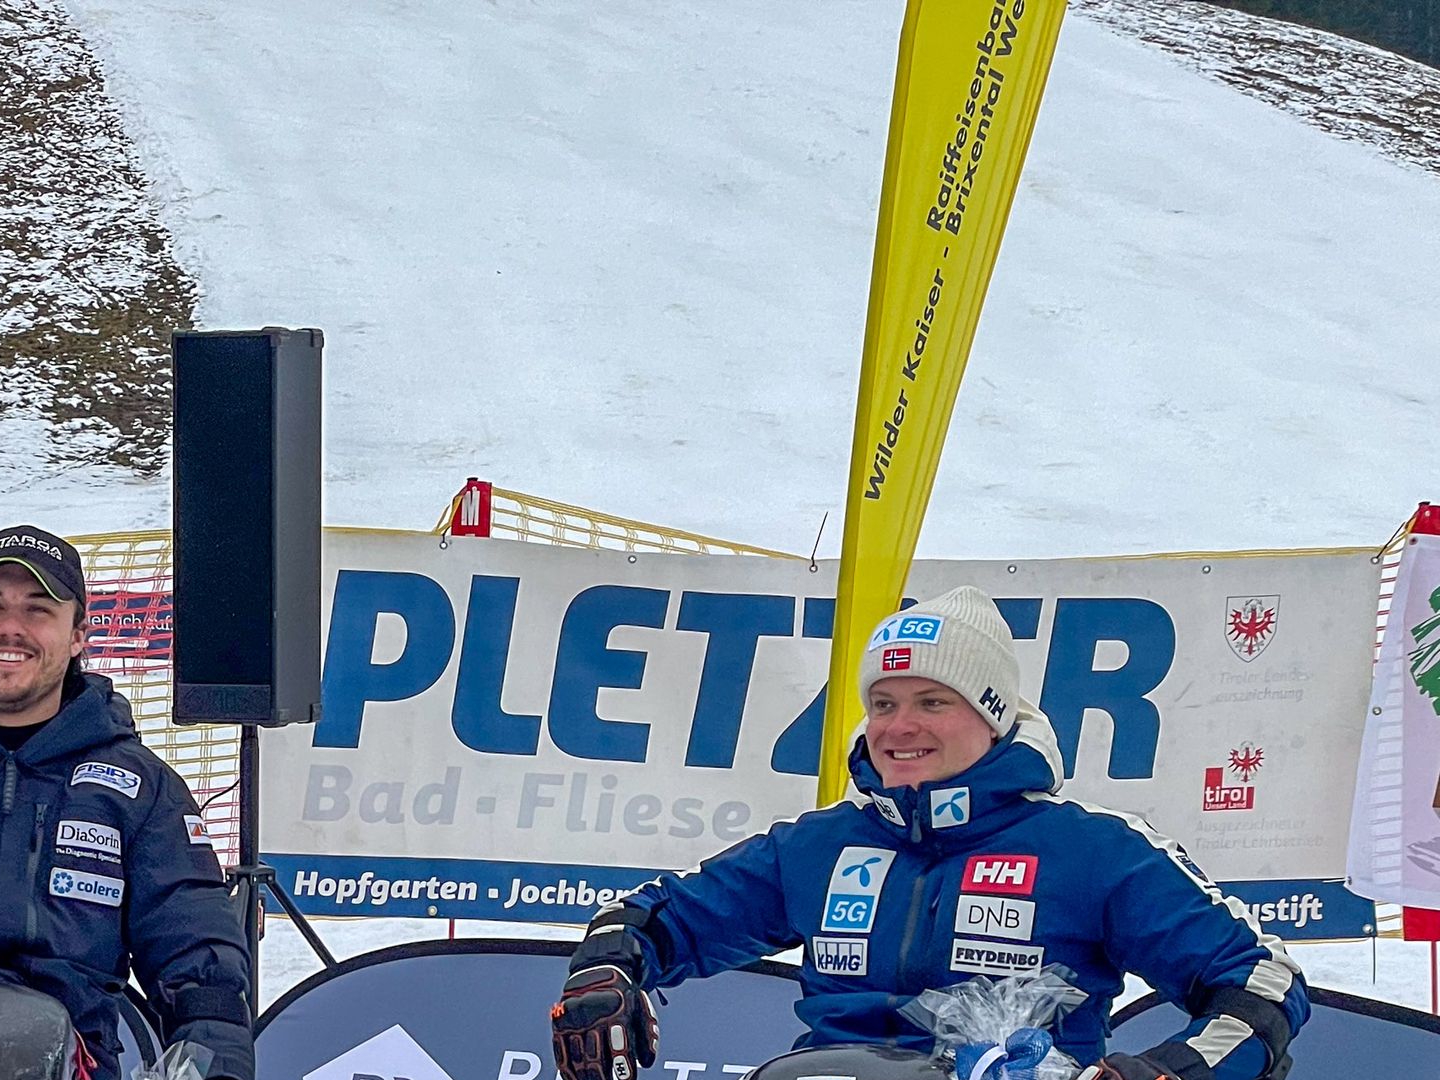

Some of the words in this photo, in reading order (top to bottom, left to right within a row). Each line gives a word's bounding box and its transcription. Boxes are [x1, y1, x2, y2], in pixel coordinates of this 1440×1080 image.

[926, 0, 1007, 231] Raiffeisenba
[864, 389, 906, 500] Wilder
[902, 269, 945, 381] Kaiser
[945, 68, 1005, 236] Brixental
[901, 619, 935, 636] 5G
[978, 686, 1007, 722] HH
[74, 763, 127, 779] FISIP
[302, 764, 462, 826] Bad
[516, 772, 751, 841] Fliese
[1205, 786, 1248, 804] tirol
[1228, 801, 1247, 809] Land
[60, 825, 120, 849] DiaSorin
[972, 861, 1027, 885] HH
[76, 880, 121, 898] colere
[294, 871, 478, 906] Hopfgarten
[831, 900, 868, 923] 5G
[968, 900, 1020, 933] DNB
[816, 952, 861, 971] KPMG
[955, 946, 1040, 967] FRYDENBØ
